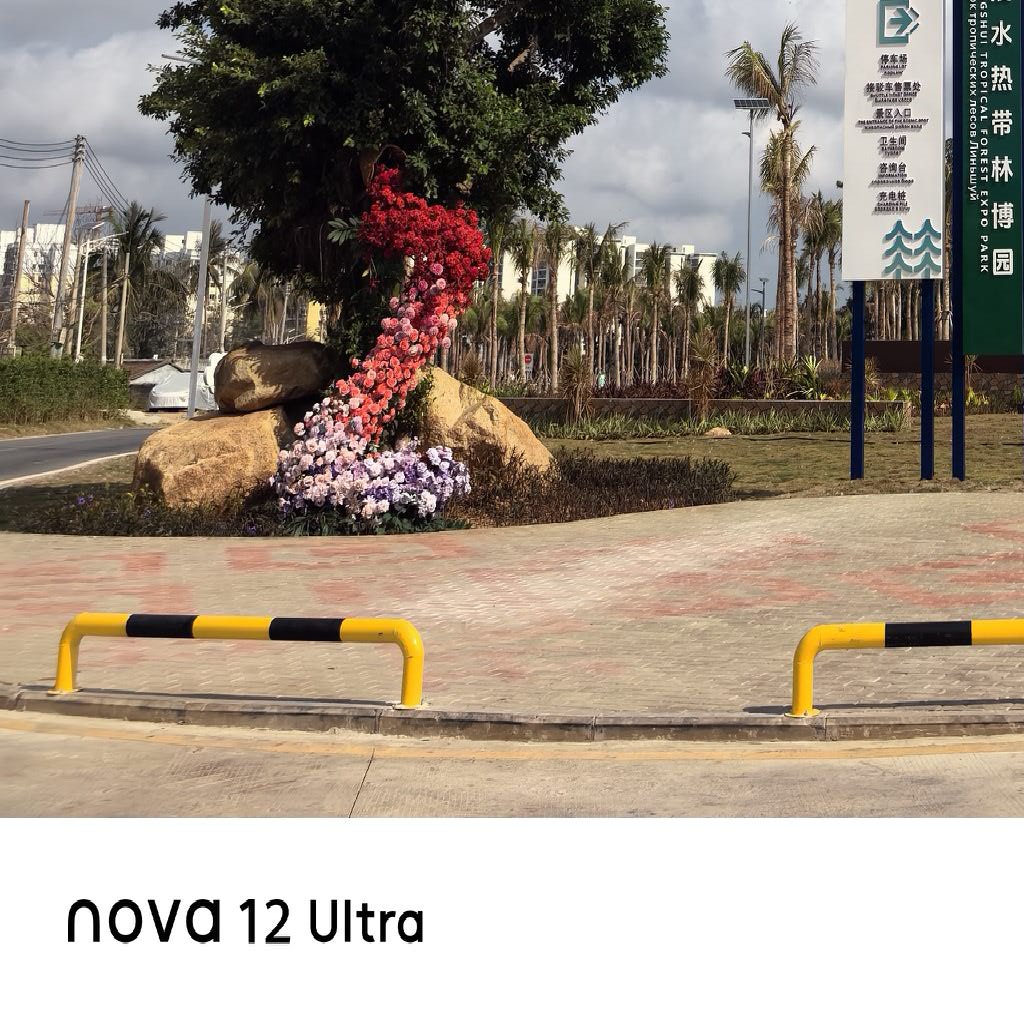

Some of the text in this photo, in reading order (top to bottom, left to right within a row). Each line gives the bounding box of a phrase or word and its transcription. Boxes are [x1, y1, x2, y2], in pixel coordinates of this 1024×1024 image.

[880, 53, 908, 65] 停车场
[866, 81, 922, 93] 接驳车售票处
[980, 52, 988, 122] TROPICAL
[875, 108, 912, 119] 景区入口
[969, 99, 977, 138] лесов
[879, 135, 907, 146] 卫生间
[980, 128, 989, 182] FOREST
[879, 162, 907, 174] 咨询台
[879, 191, 907, 202] 充电桩
[980, 191, 989, 227] EXPO
[980, 235, 989, 272] PARK
